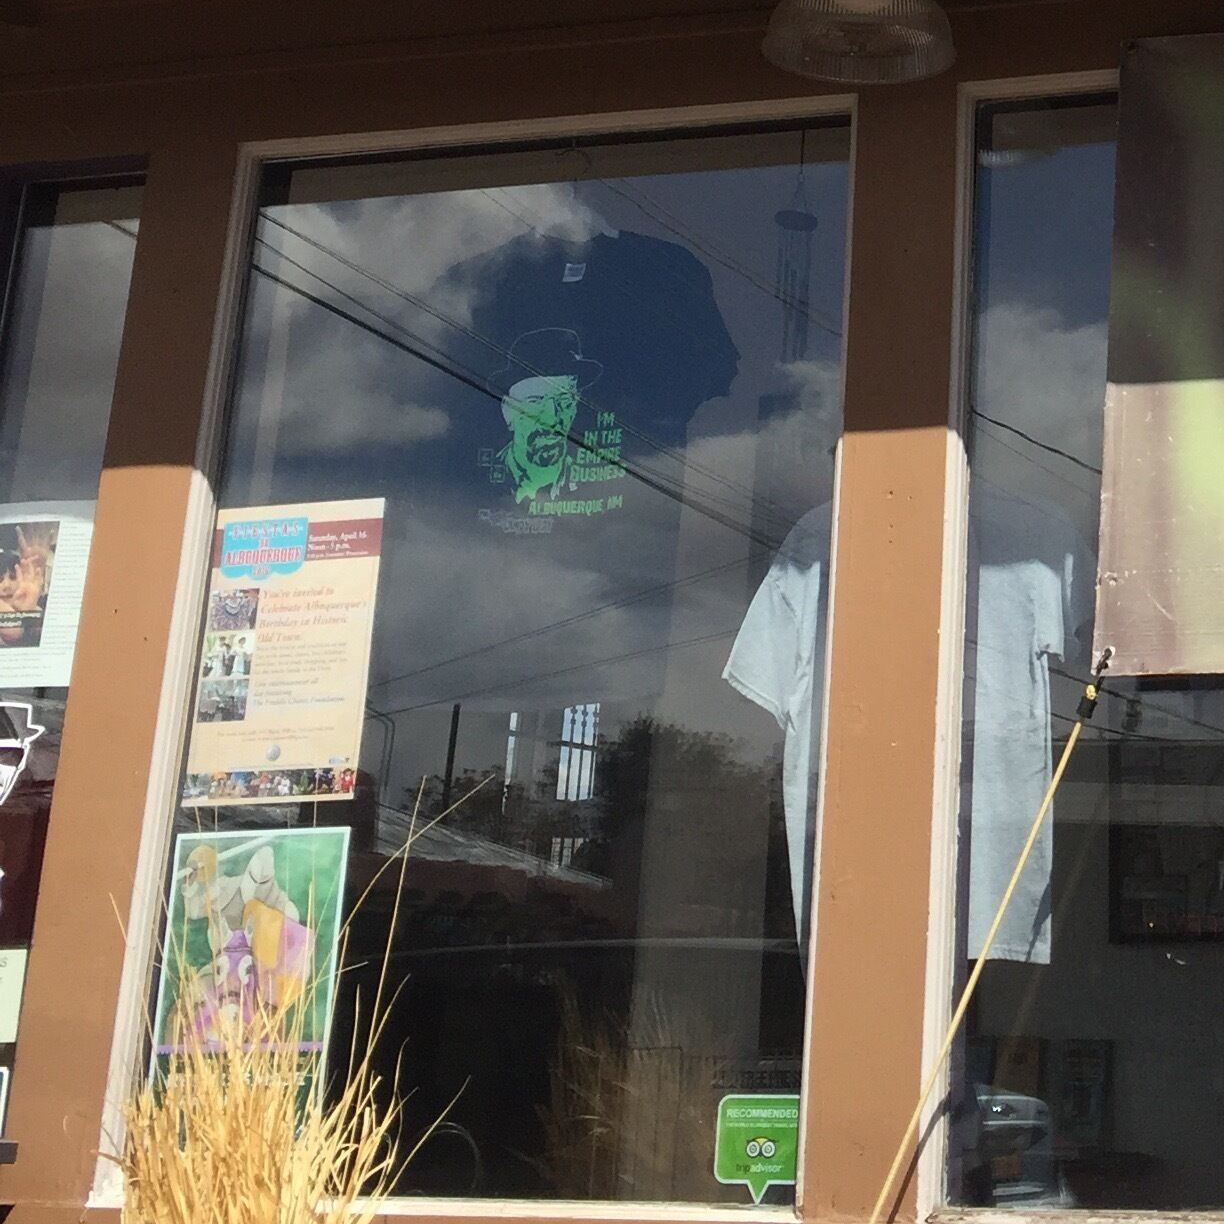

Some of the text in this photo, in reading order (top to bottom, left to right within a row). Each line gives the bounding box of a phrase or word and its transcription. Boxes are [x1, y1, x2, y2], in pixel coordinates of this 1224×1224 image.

[583, 428, 623, 446] IN THE
[726, 1108, 799, 1119] RECOMMENDED
